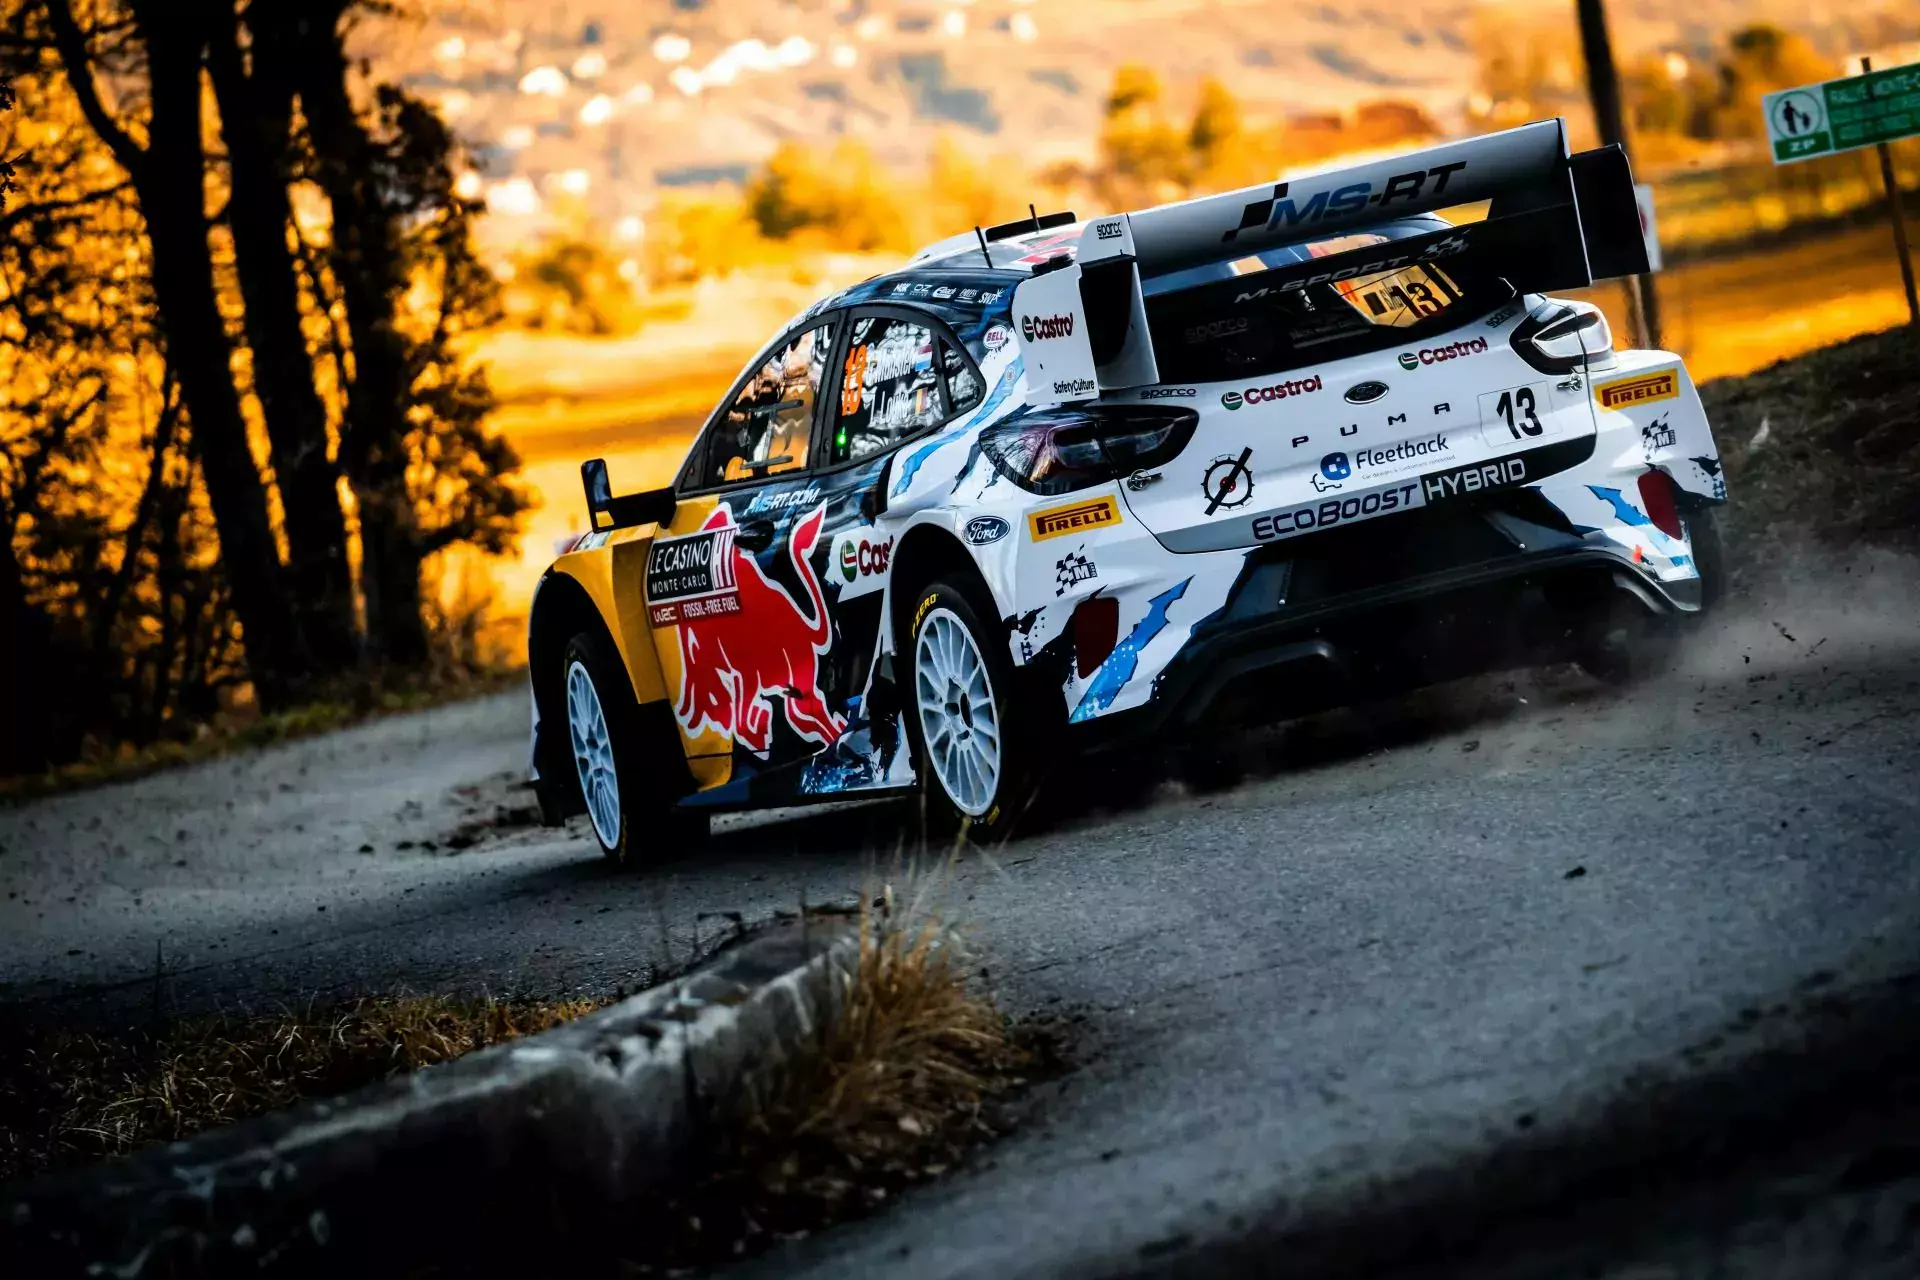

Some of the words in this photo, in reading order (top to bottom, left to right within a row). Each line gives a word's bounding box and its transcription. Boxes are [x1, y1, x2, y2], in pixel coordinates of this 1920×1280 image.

[1266, 160, 1467, 232] MS-RT
[1234, 255, 1409, 304] M-SPORT
[1389, 282, 1444, 319] 13
[986, 331, 1004, 342] BELL
[1418, 335, 1489, 365] Castrol
[1053, 378, 1095, 396] SafetyCulture
[1140, 387, 1197, 399] sparco
[1243, 375, 1323, 405] Castrol
[1602, 375, 1672, 407] PIRELLI
[1291, 402, 1451, 448] PUMA
[1496, 387, 1544, 440] 13
[1356, 433, 1449, 469] Fleetback
[1425, 459, 1526, 501] HYBRID
[968, 520, 999, 541] Ford
[1036, 502, 1113, 535] PIRELLI
[649, 548, 664, 575] LE
[664, 540, 711, 572] CASINO
[653, 606, 677, 623] WRC
[722, 596, 740, 613] FUEL
